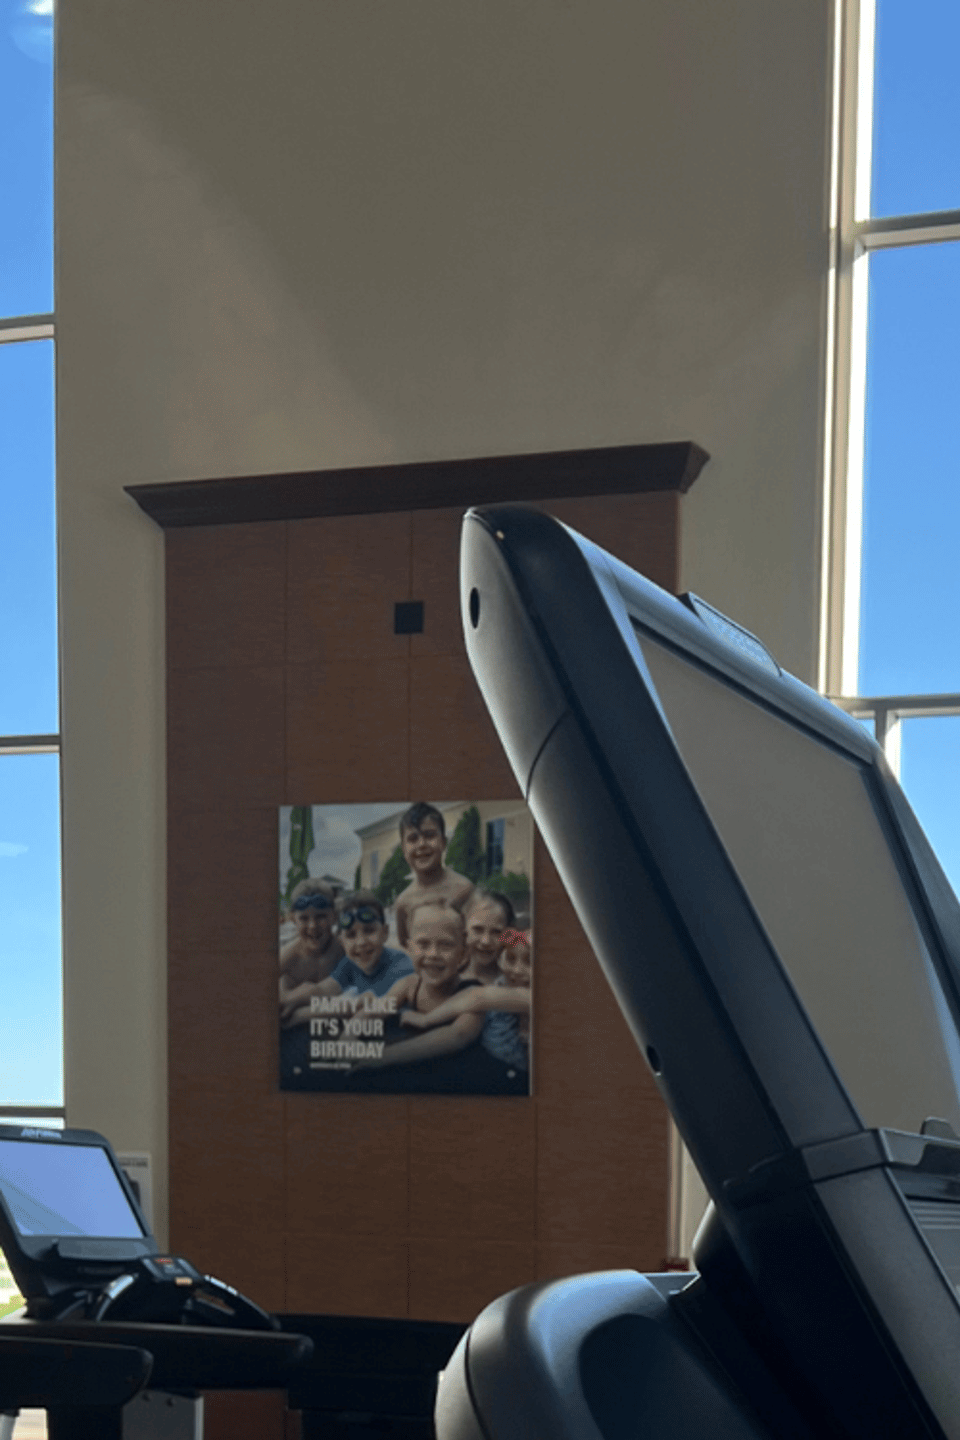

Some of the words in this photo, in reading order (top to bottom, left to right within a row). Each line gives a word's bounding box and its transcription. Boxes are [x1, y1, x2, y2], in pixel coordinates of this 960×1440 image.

[310, 996, 357, 1014] PARTY
[364, 997, 397, 1014] LIKE
[310, 1018, 339, 1036] IT'S
[342, 1018, 384, 1036] YOUR
[310, 1041, 385, 1058] BIRTHDAY
